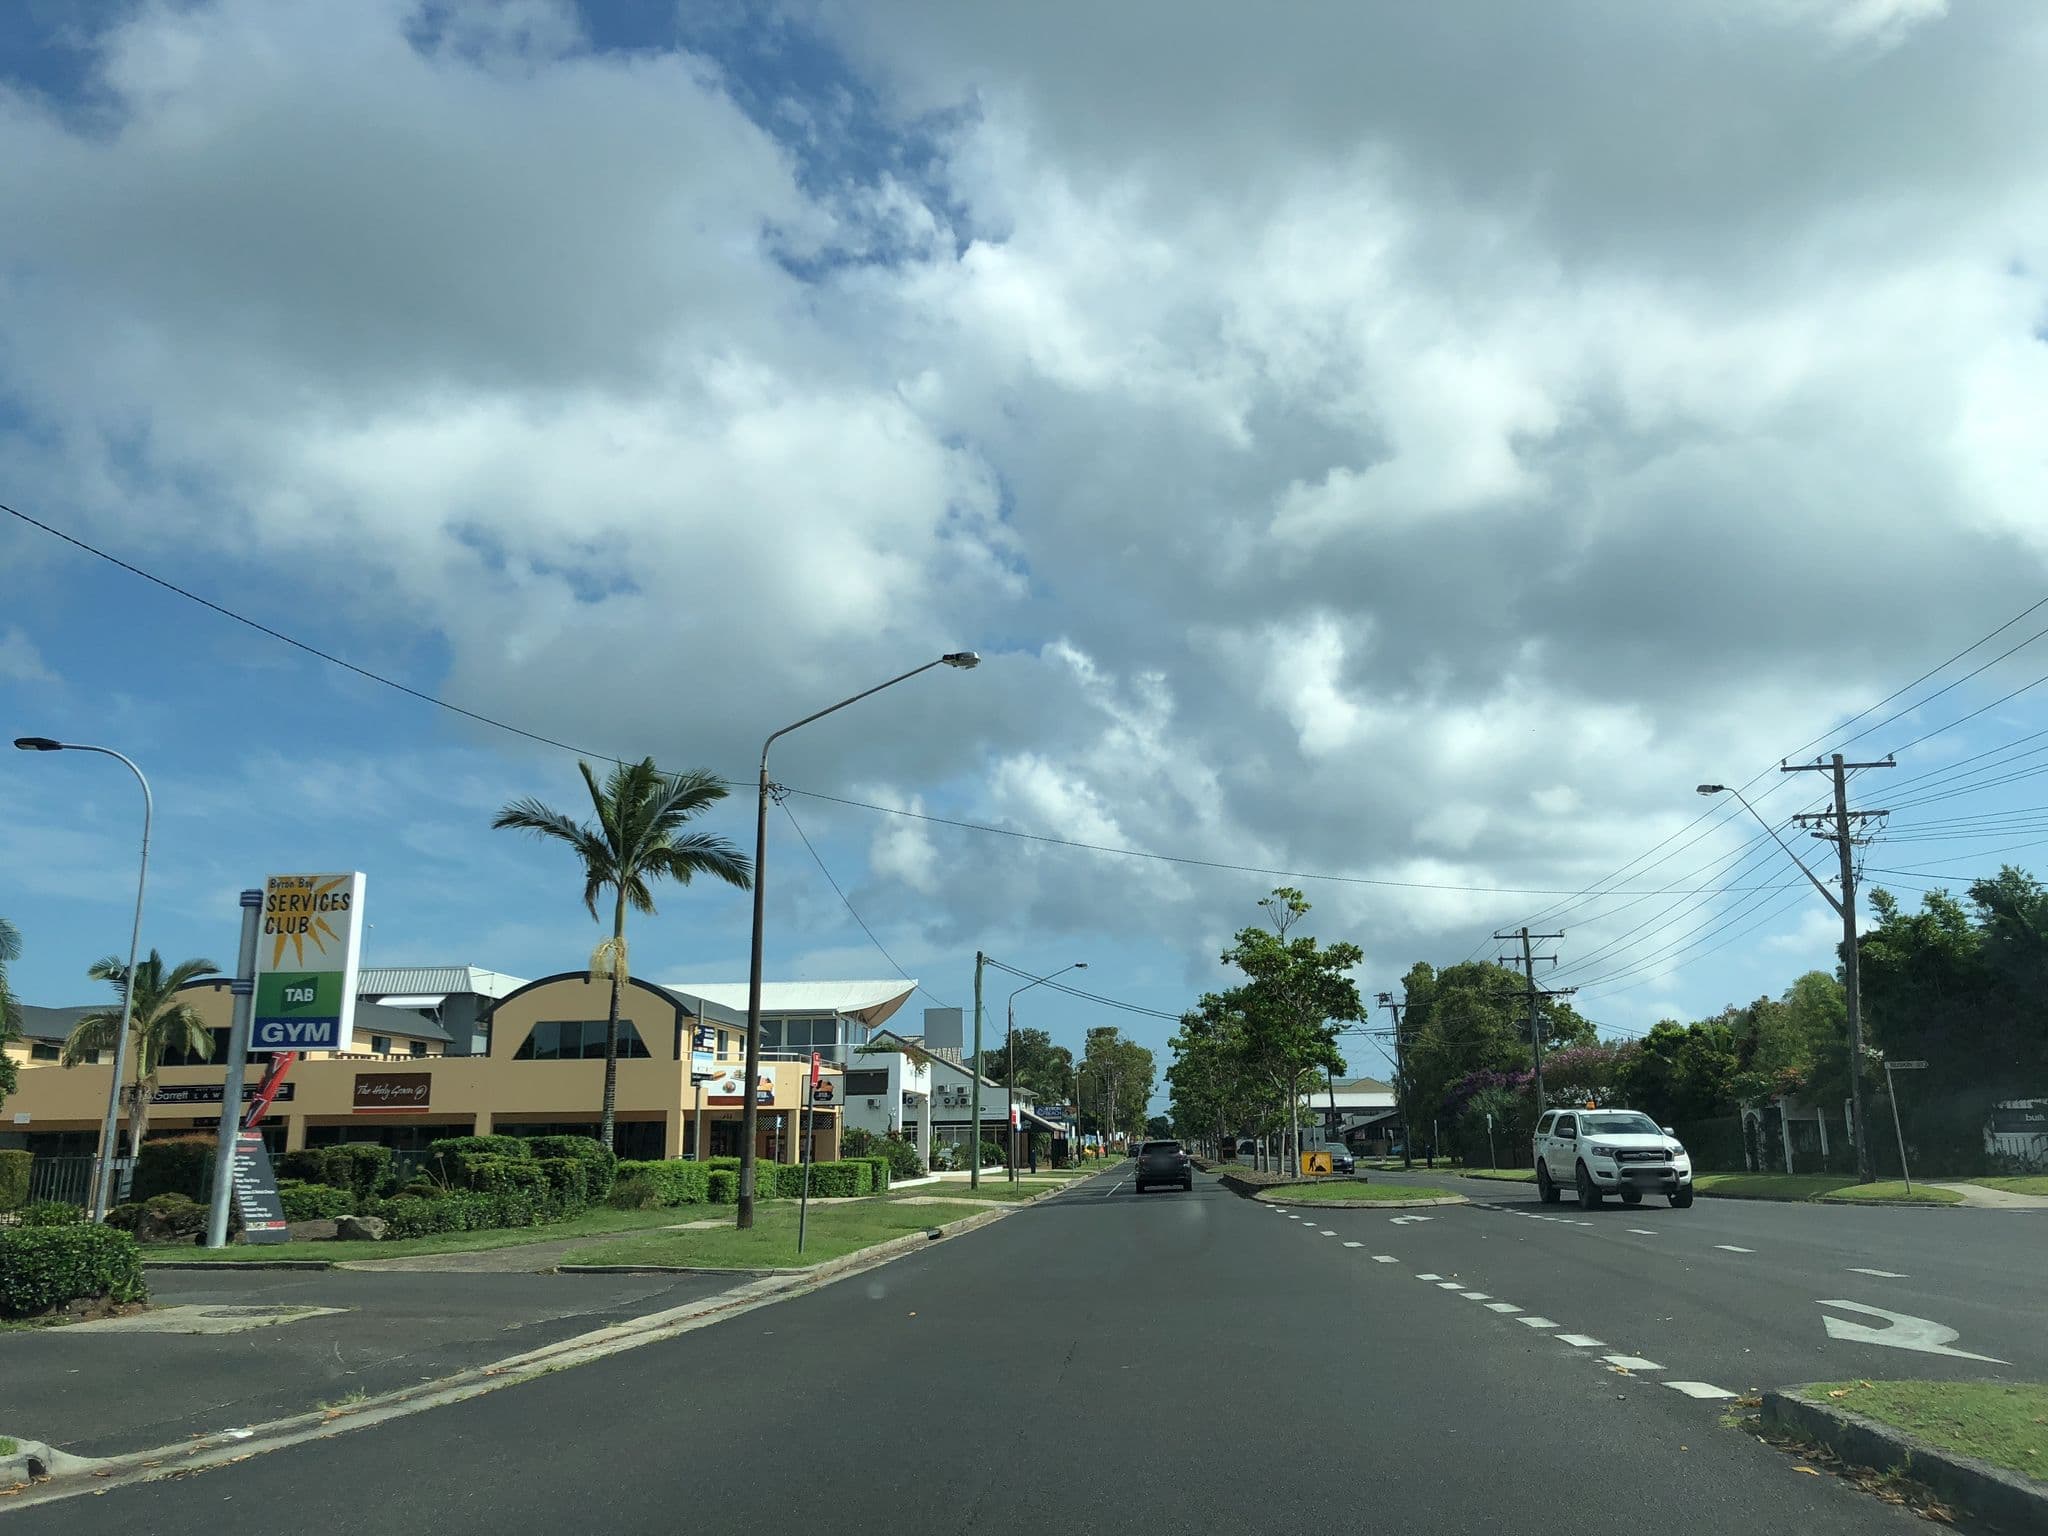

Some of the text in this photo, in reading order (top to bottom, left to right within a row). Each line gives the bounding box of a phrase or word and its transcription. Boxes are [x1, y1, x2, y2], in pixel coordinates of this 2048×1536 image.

[270, 878, 314, 890] Byron Bay
[266, 892, 351, 912] SERVICES
[264, 916, 310, 935] CLUB
[285, 988, 314, 1002] TAB
[261, 1022, 331, 1043] GYM
[154, 1088, 189, 1101] Garrett
[357, 1082, 372, 1095] The
